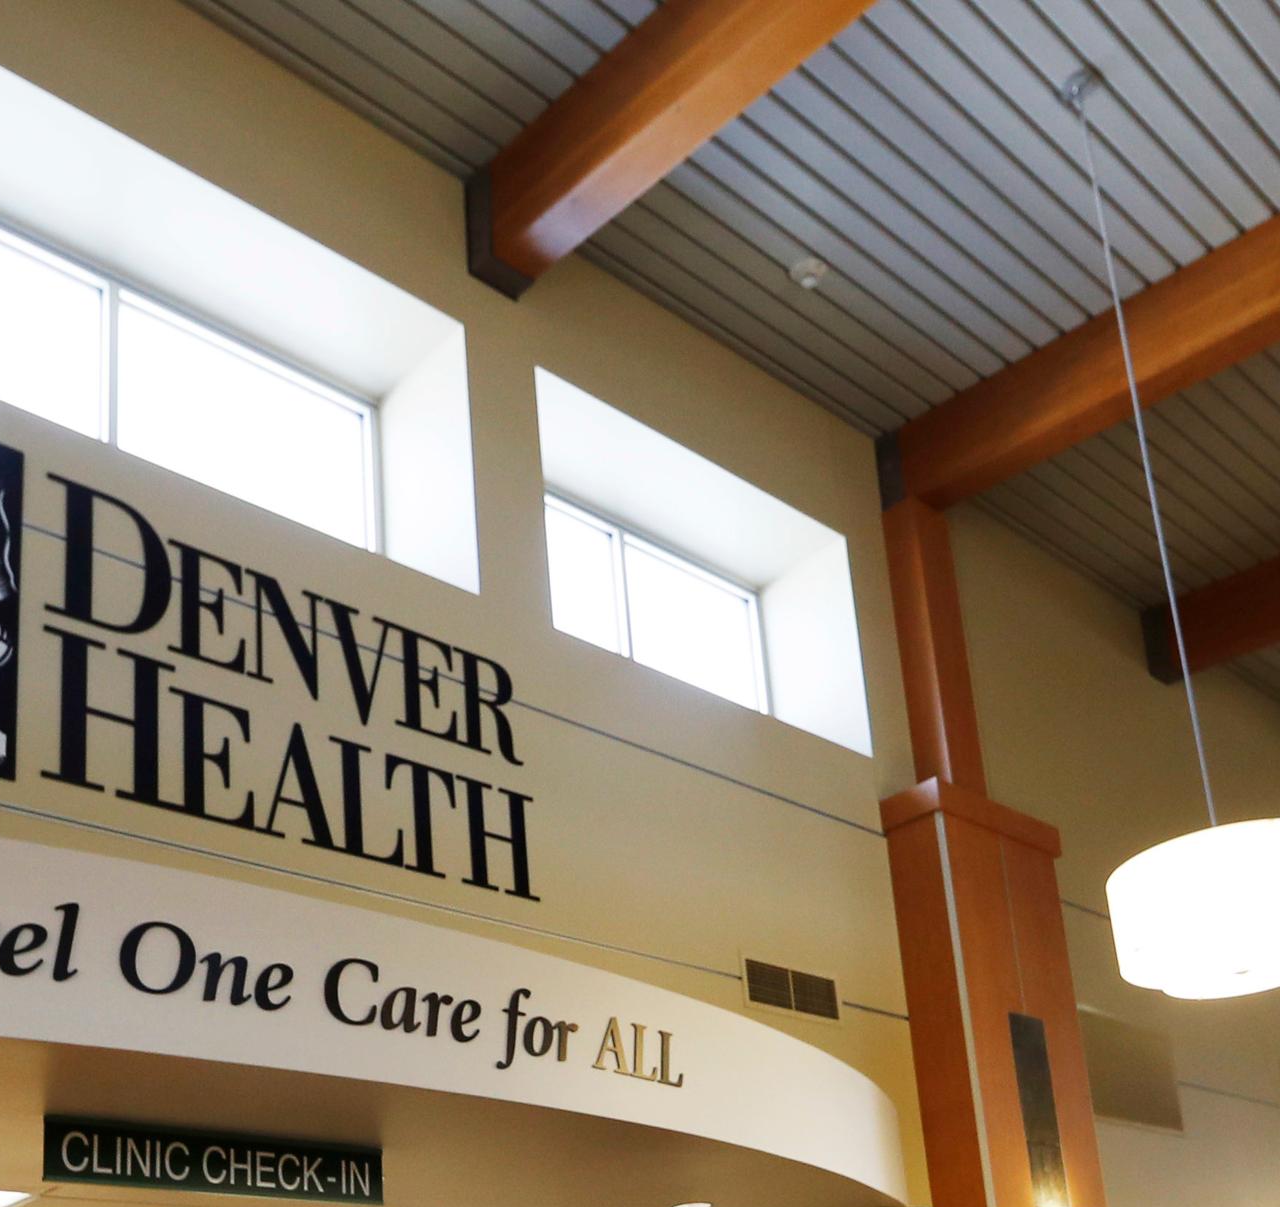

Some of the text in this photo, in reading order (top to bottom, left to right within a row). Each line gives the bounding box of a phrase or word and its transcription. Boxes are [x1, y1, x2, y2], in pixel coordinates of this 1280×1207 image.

[43, 472, 524, 766] DENVER
[40, 624, 541, 903] HEALTH
[119, 920, 295, 1012] One
[323, 957, 482, 1043] Care
[496, 988, 579, 1070] for
[591, 1016, 684, 1088] ALL
[61, 1131, 371, 1197] CLINIC CHECK-IN
